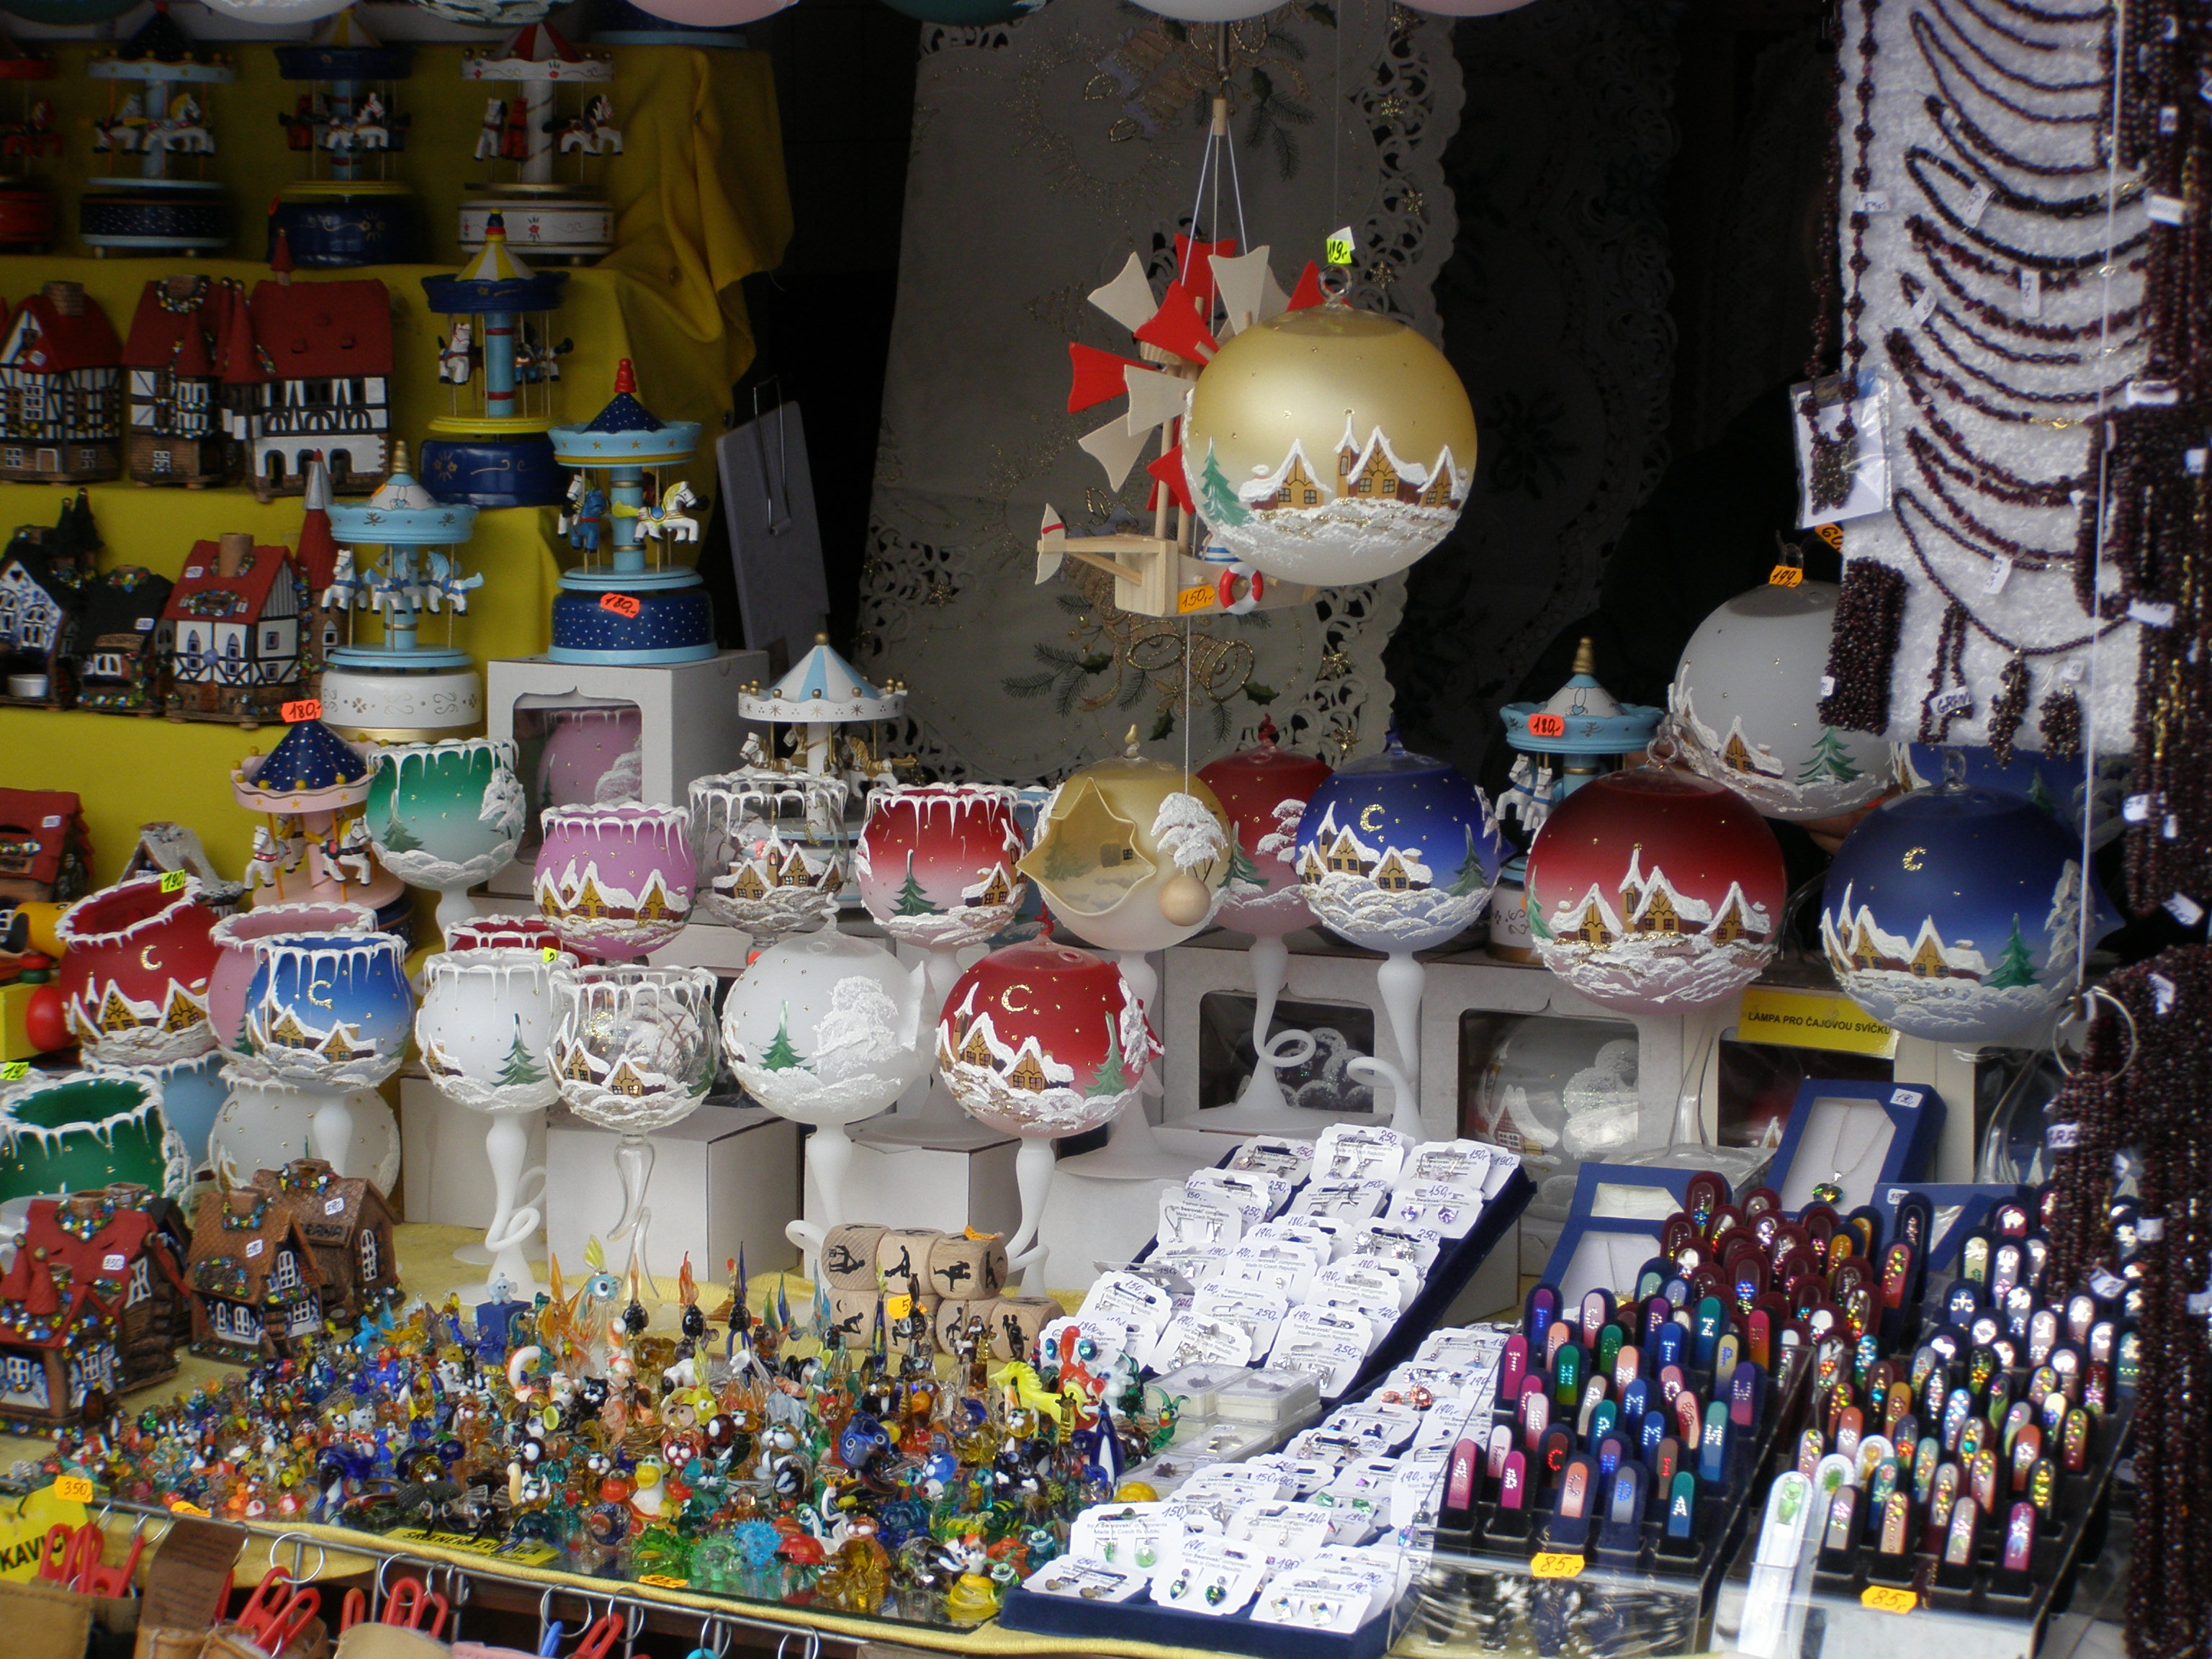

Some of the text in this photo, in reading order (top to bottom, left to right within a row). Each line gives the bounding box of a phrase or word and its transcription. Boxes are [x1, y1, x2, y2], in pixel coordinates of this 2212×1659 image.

[1182, 588, 1216, 608] 150,-
[289, 702, 322, 720] 180,-
[1533, 716, 1561, 736] 180,-
[1748, 1012, 1780, 1023] LAMPA
[1783, 1015, 1803, 1025] PRO
[1855, 1021, 1892, 1035] SVÍČKU
[1535, 1308, 1548, 1328] T
[1701, 1316, 1715, 1337] Z
[1624, 1393, 1644, 1416] M
[1642, 1424, 1662, 1447] M
[1547, 1448, 1563, 1471] C
[1672, 1495, 1688, 1517] A
[1539, 1555, 1580, 1575] 85,-
[1871, 1588, 1907, 1611] 85,-
